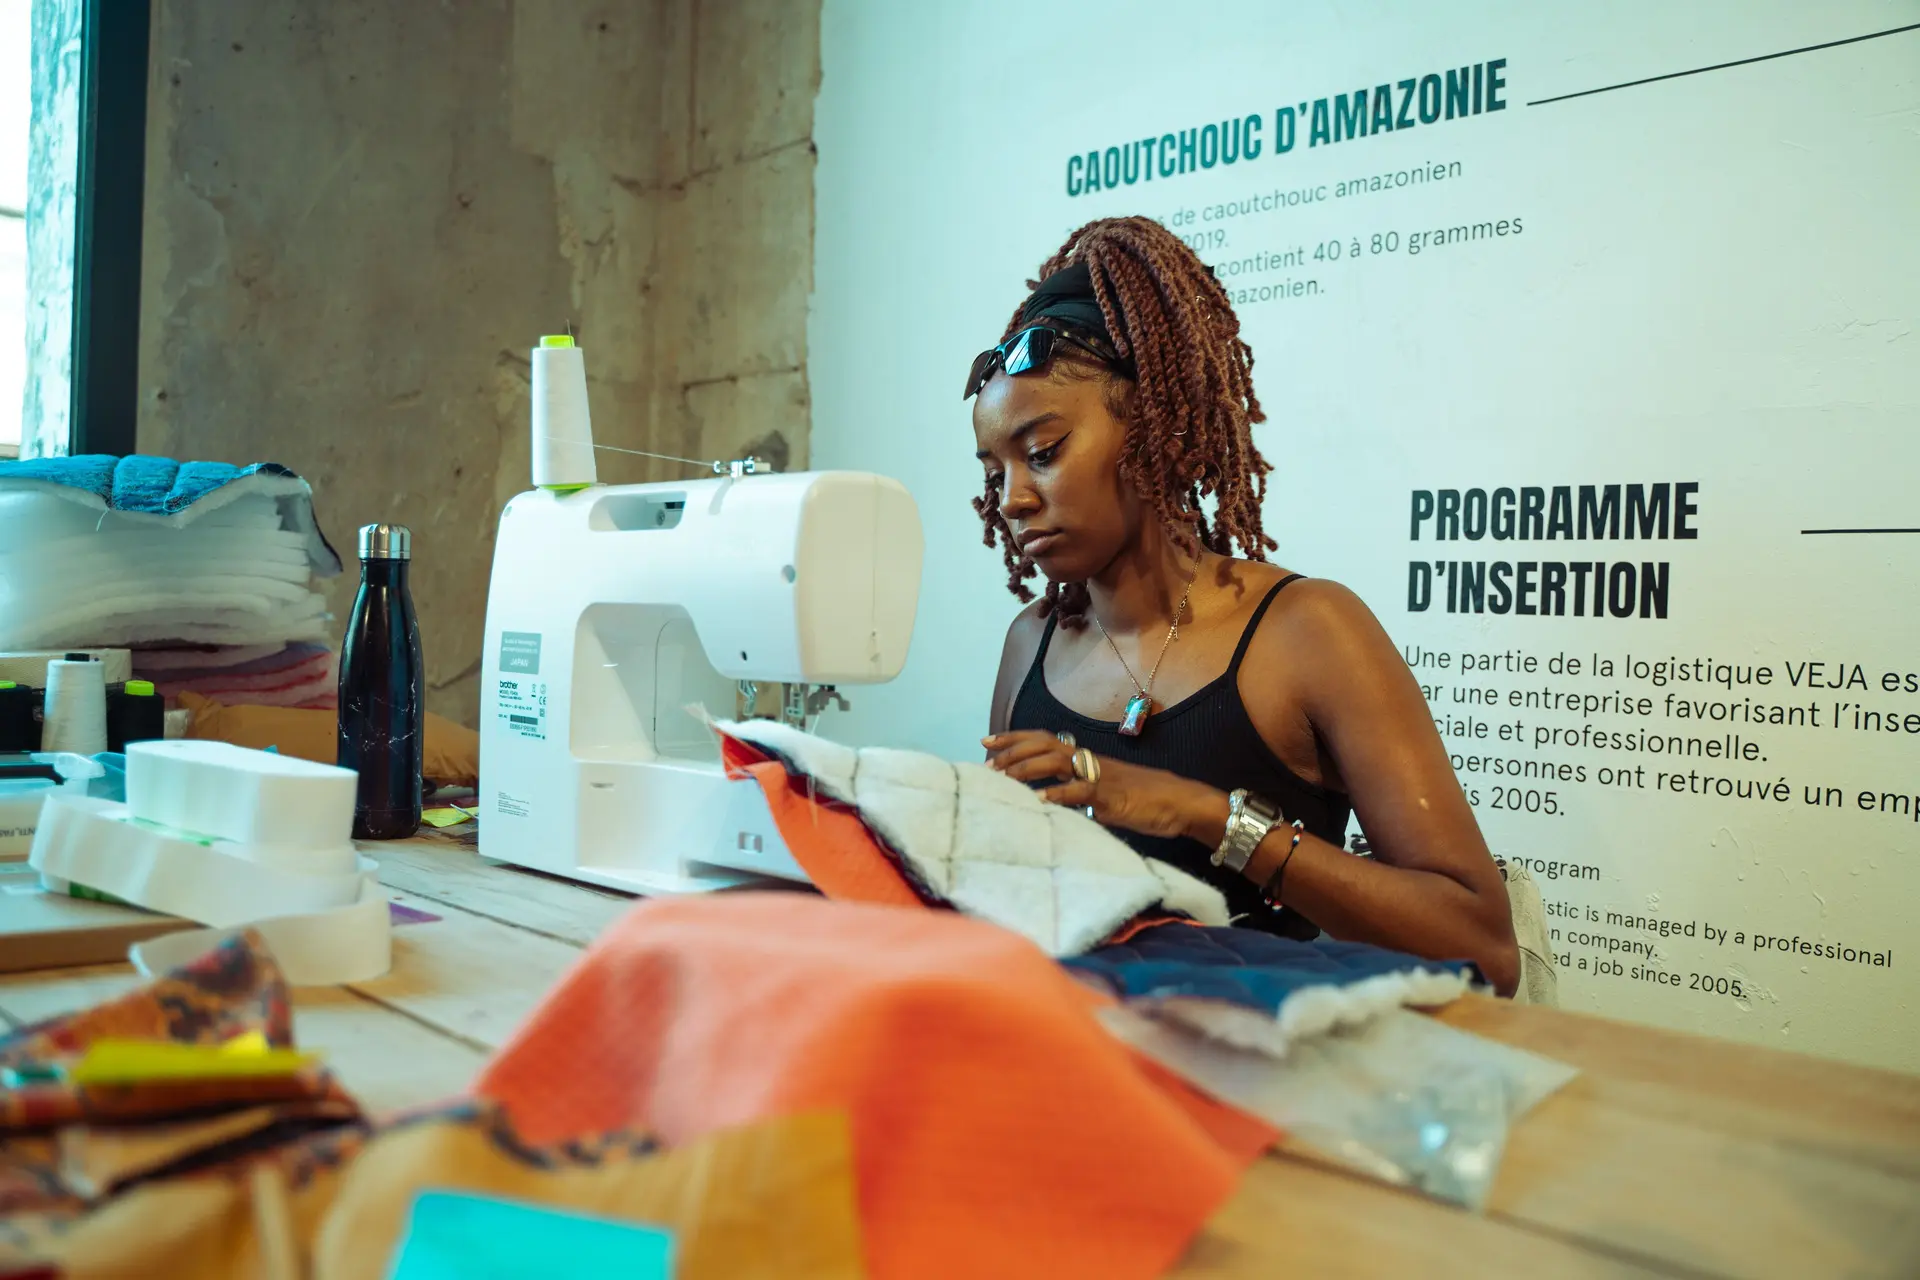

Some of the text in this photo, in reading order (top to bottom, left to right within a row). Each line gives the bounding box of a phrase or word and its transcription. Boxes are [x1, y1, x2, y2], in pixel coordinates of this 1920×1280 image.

[1067, 58, 1506, 197] CAOUTCHOUC D'AMAZONIE
[1172, 160, 1461, 228] de caoutchouc amazonien
[1216, 217, 1522, 278] contient 40 à 80 grammes
[1410, 482, 1699, 541] PROGRAMME
[1407, 561, 1670, 619] D'INSERTION
[500, 680, 518, 689] brother
[1405, 645, 1451, 669] Une
[1461, 650, 1538, 676] partie
[1549, 652, 1582, 676] de
[1593, 653, 1614, 677] la
[1626, 655, 1774, 691] logistique
[1785, 661, 1869, 691] VEJA
[1420, 682, 1444, 703] ar
[1453, 687, 1498, 706] une
[1508, 688, 1653, 718] entreprise
[1665, 693, 1821, 728] favorisant
[1433, 714, 1768, 763] ciale et professionnelle.
[1450, 752, 1587, 784] personnes
[1598, 765, 1645, 788] ont
[1658, 770, 1791, 803] retrouvé
[1805, 786, 1843, 808] un
[1491, 786, 1565, 816] 2005.
[1567, 930, 1659, 958] company.
[1586, 905, 1600, 923] is
[1607, 913, 1696, 939] managed
[1704, 923, 1728, 946] by
[1734, 931, 1746, 945] a
[1754, 935, 1892, 967] professional
[1577, 957, 1588, 971] a
[1593, 956, 1624, 977] job
[1631, 964, 1682, 987] since
[1689, 973, 1748, 999] 2005.
